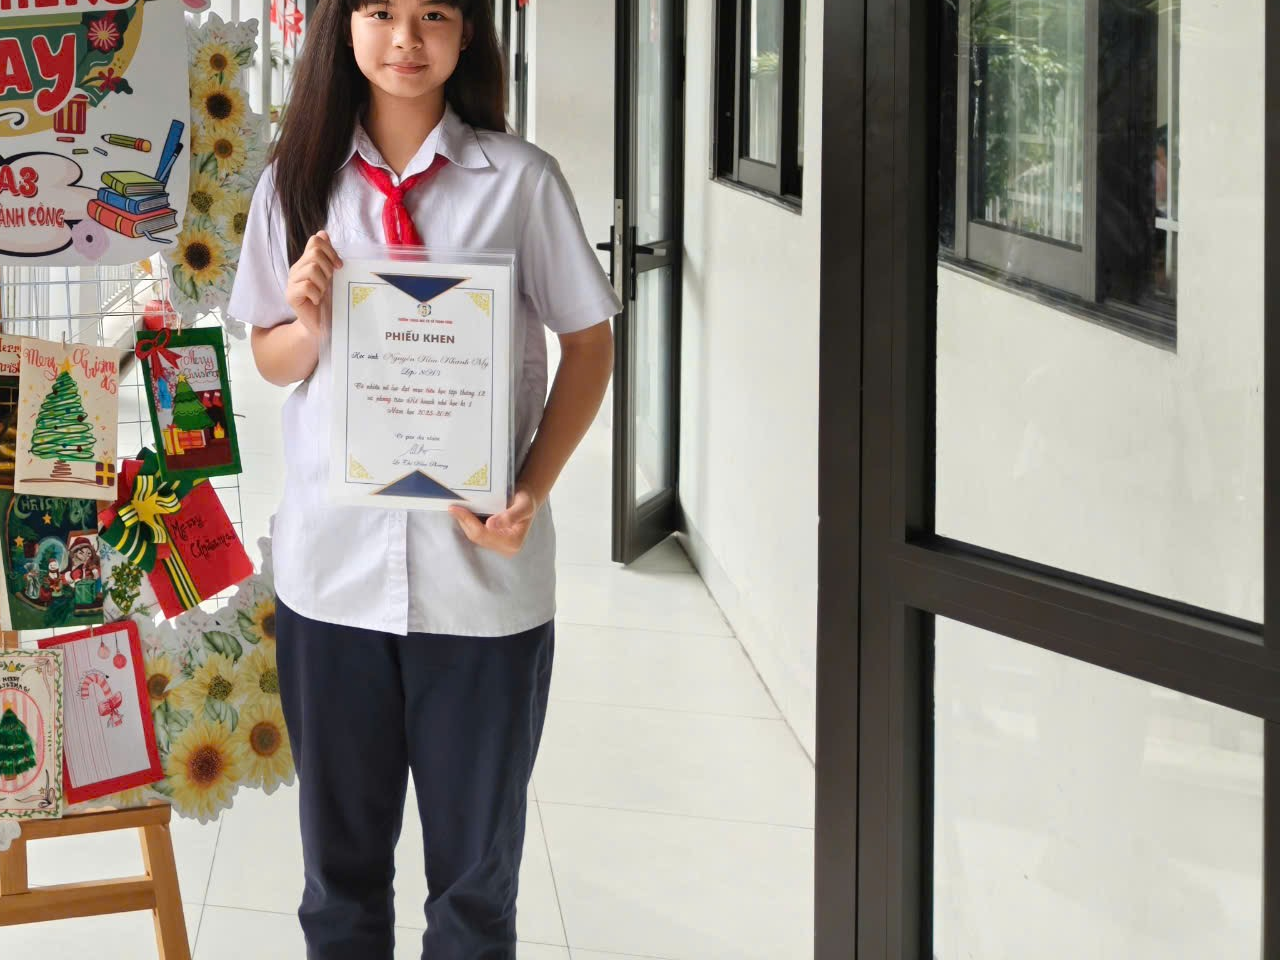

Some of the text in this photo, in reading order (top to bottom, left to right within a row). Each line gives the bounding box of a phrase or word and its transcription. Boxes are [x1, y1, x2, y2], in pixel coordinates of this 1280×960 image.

[28, 202, 65, 228] CÔNG
[385, 330, 455, 344] PHIẾU KHEN
